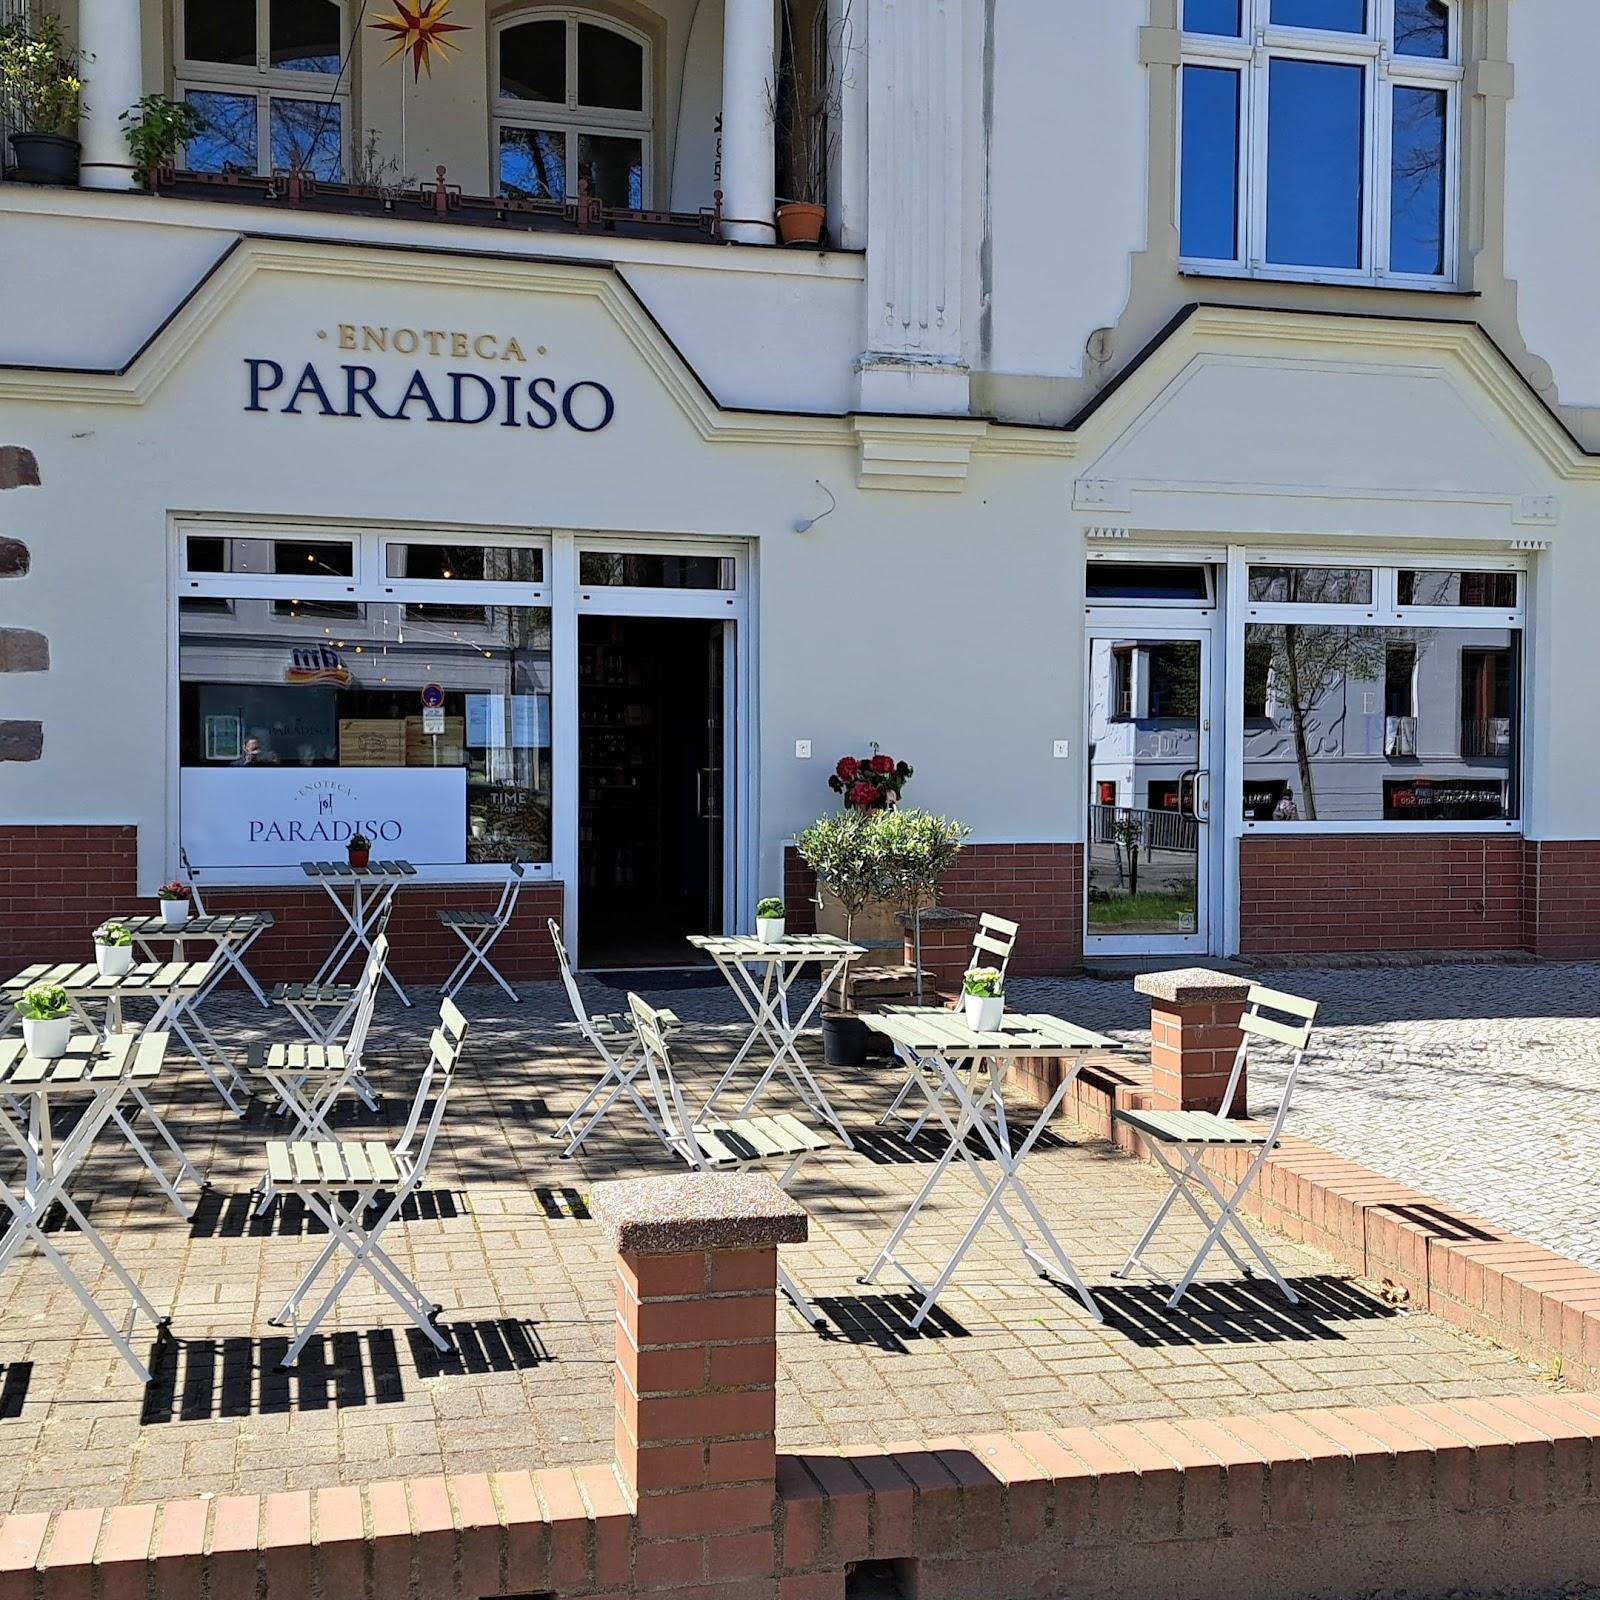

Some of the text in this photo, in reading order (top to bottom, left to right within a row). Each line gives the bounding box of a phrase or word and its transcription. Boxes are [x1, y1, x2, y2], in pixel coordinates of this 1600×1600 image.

[338, 324, 527, 361] ENOTECA
[244, 358, 614, 431] PARADISO
[490, 793, 527, 804] TIME
[249, 820, 402, 842] PARADISO
